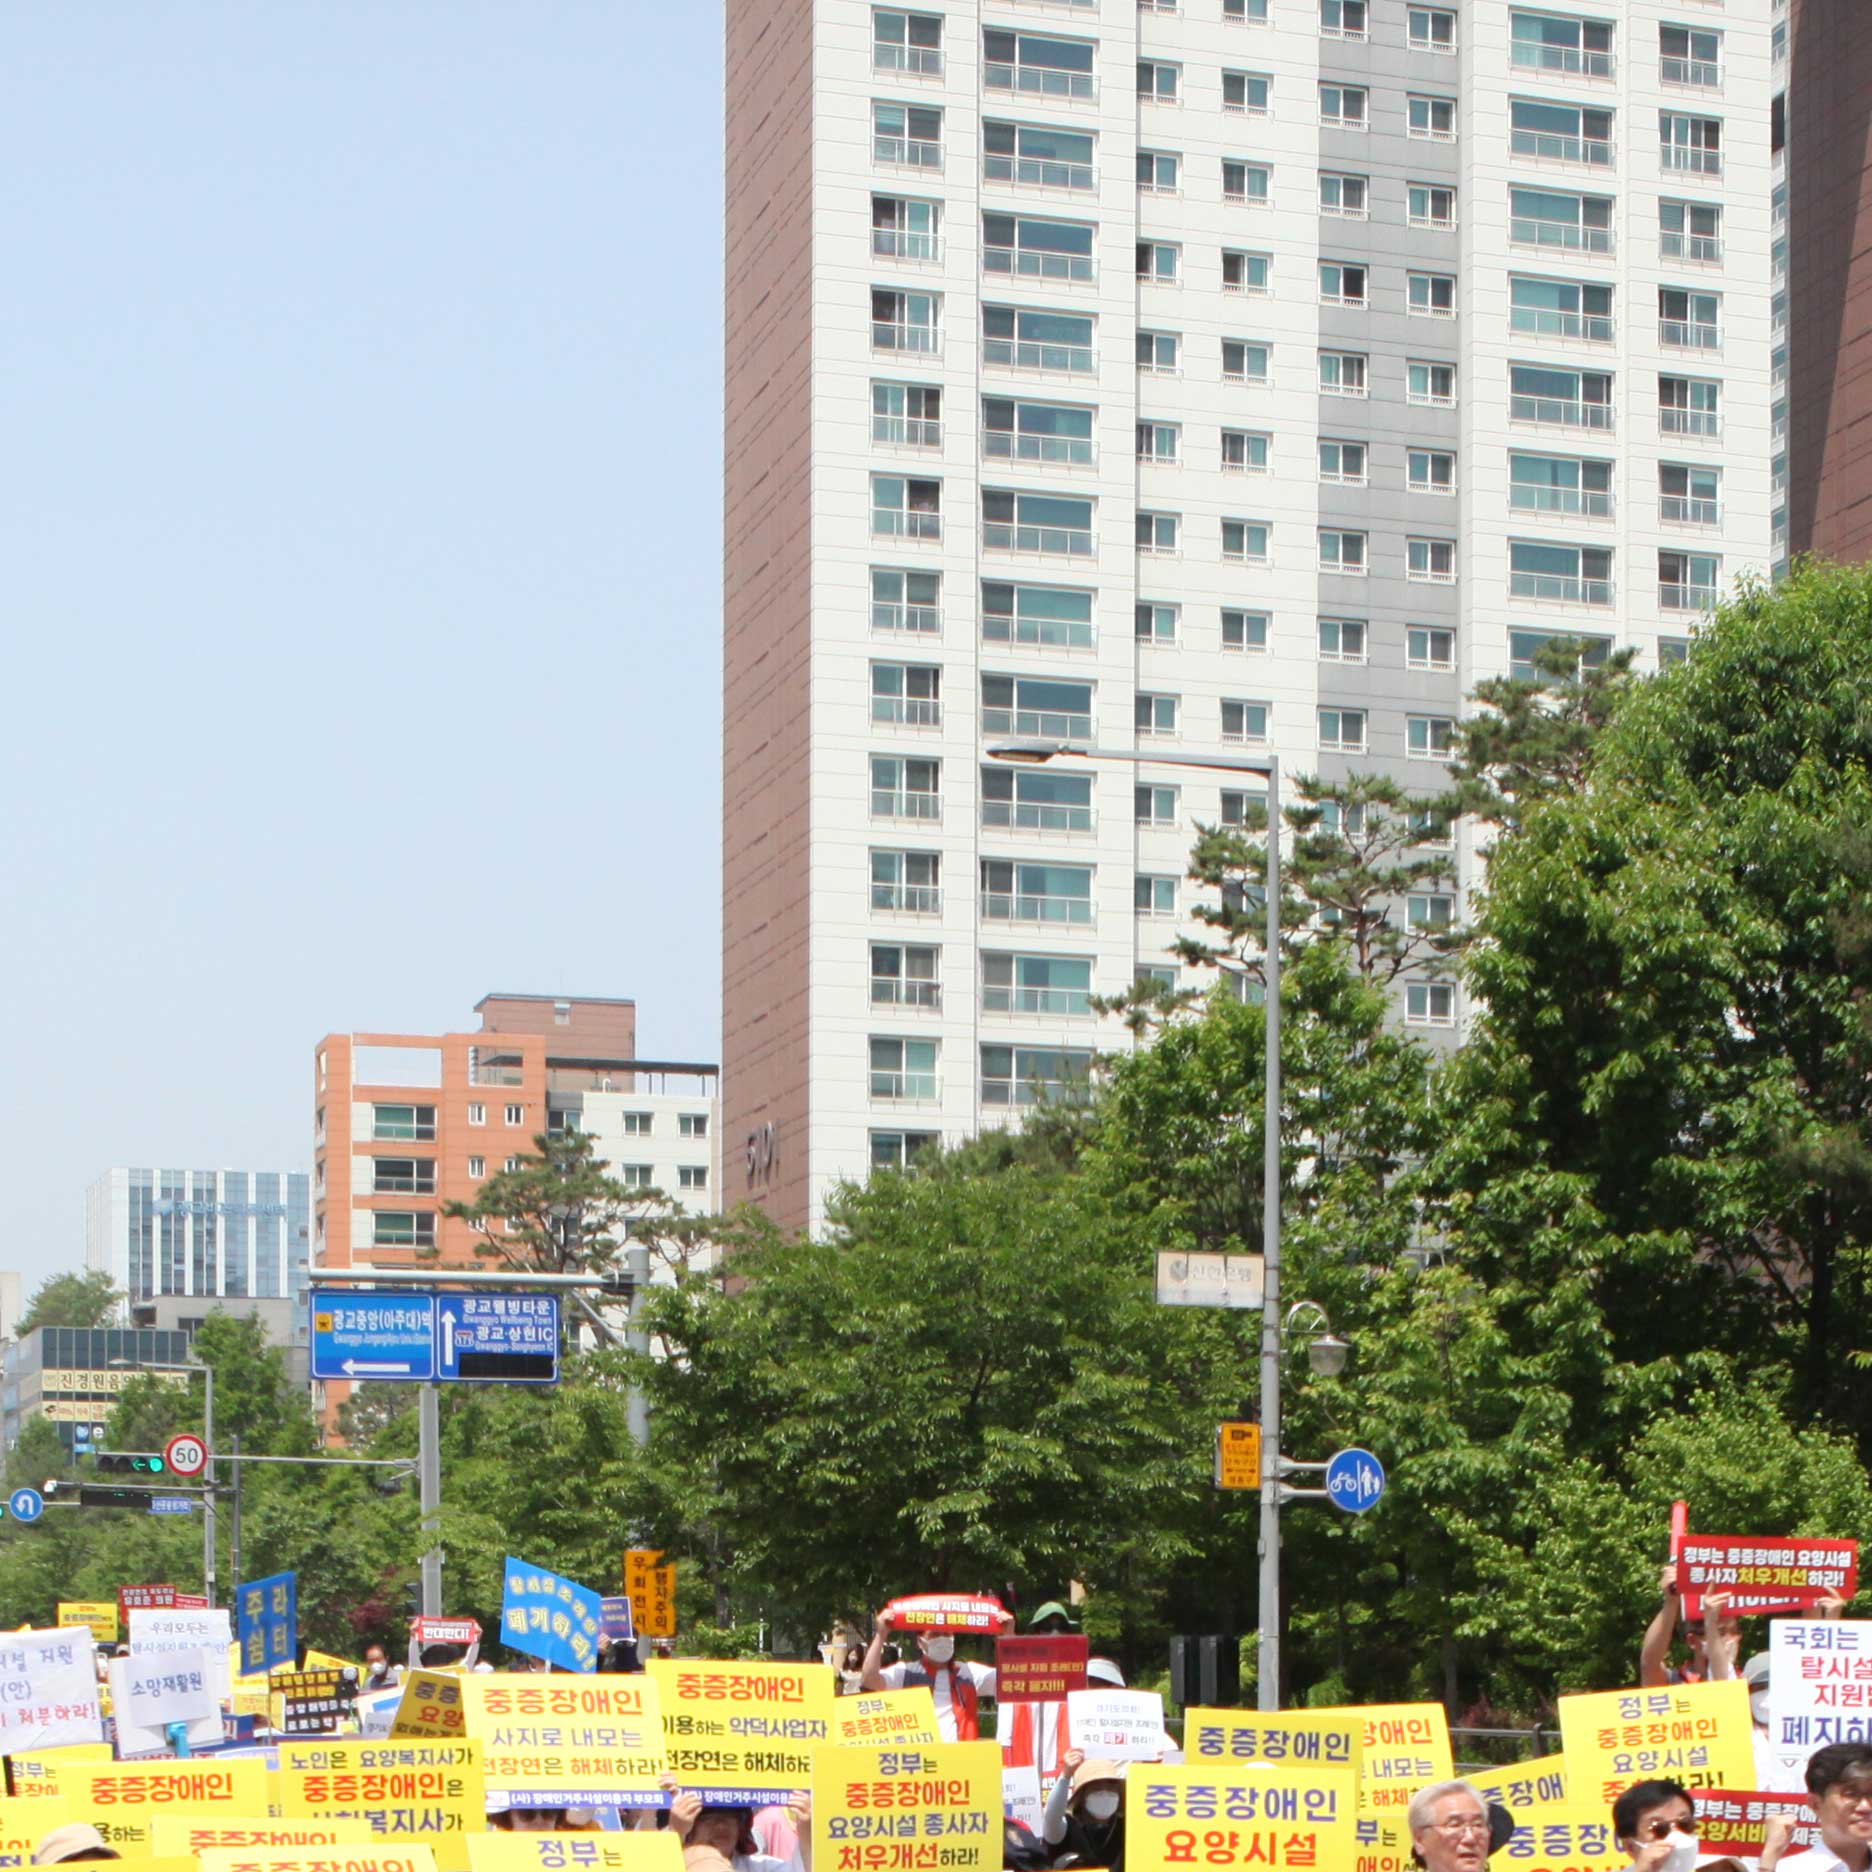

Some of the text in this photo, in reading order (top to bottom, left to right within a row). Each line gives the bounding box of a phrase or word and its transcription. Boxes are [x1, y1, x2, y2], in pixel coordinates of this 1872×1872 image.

[176, 1448, 198, 1464] 50
[1683, 1547, 1852, 1569] 정부는 중증장애인 요양시설
[1784, 1625, 1859, 1651] 국회는
[40, 1645, 73, 1667] 지원
[131, 1672, 202, 1698] 소망재활원
[676, 1673, 804, 1703] 중증장애인
[19, 1704, 98, 1725] 처분하라!
[483, 1689, 643, 1716] 중증장애인
[1618, 1693, 1692, 1719] 정부는
[492, 1727, 643, 1748] 사지로 내모는
[730, 1718, 827, 1738] 악덕사업자
[841, 1713, 919, 1739] 중증장애인
[1597, 1718, 1718, 1750] 중증장애인
[1197, 1726, 1351, 1763] 중증장애인
[290, 1748, 473, 1770] 노인은 요양복지사가
[571, 1757, 663, 1776] 해체하라!
[879, 1753, 937, 1776] 정부는
[1374, 1758, 1434, 1779] 내모는
[1612, 1745, 1709, 1774] 요양시설
[91, 1772, 234, 1804] 중증장애인
[303, 1773, 464, 1803] 중증장애인은
[511, 1791, 664, 1806] (사) 장애인거주시설이용자 부모회
[845, 1780, 970, 1809] 중증장애인
[1145, 1783, 1337, 1822] 중증장애인
[828, 1813, 988, 1839] 요양시설 종사자
[1163, 1830, 1318, 1866] 요양시설
